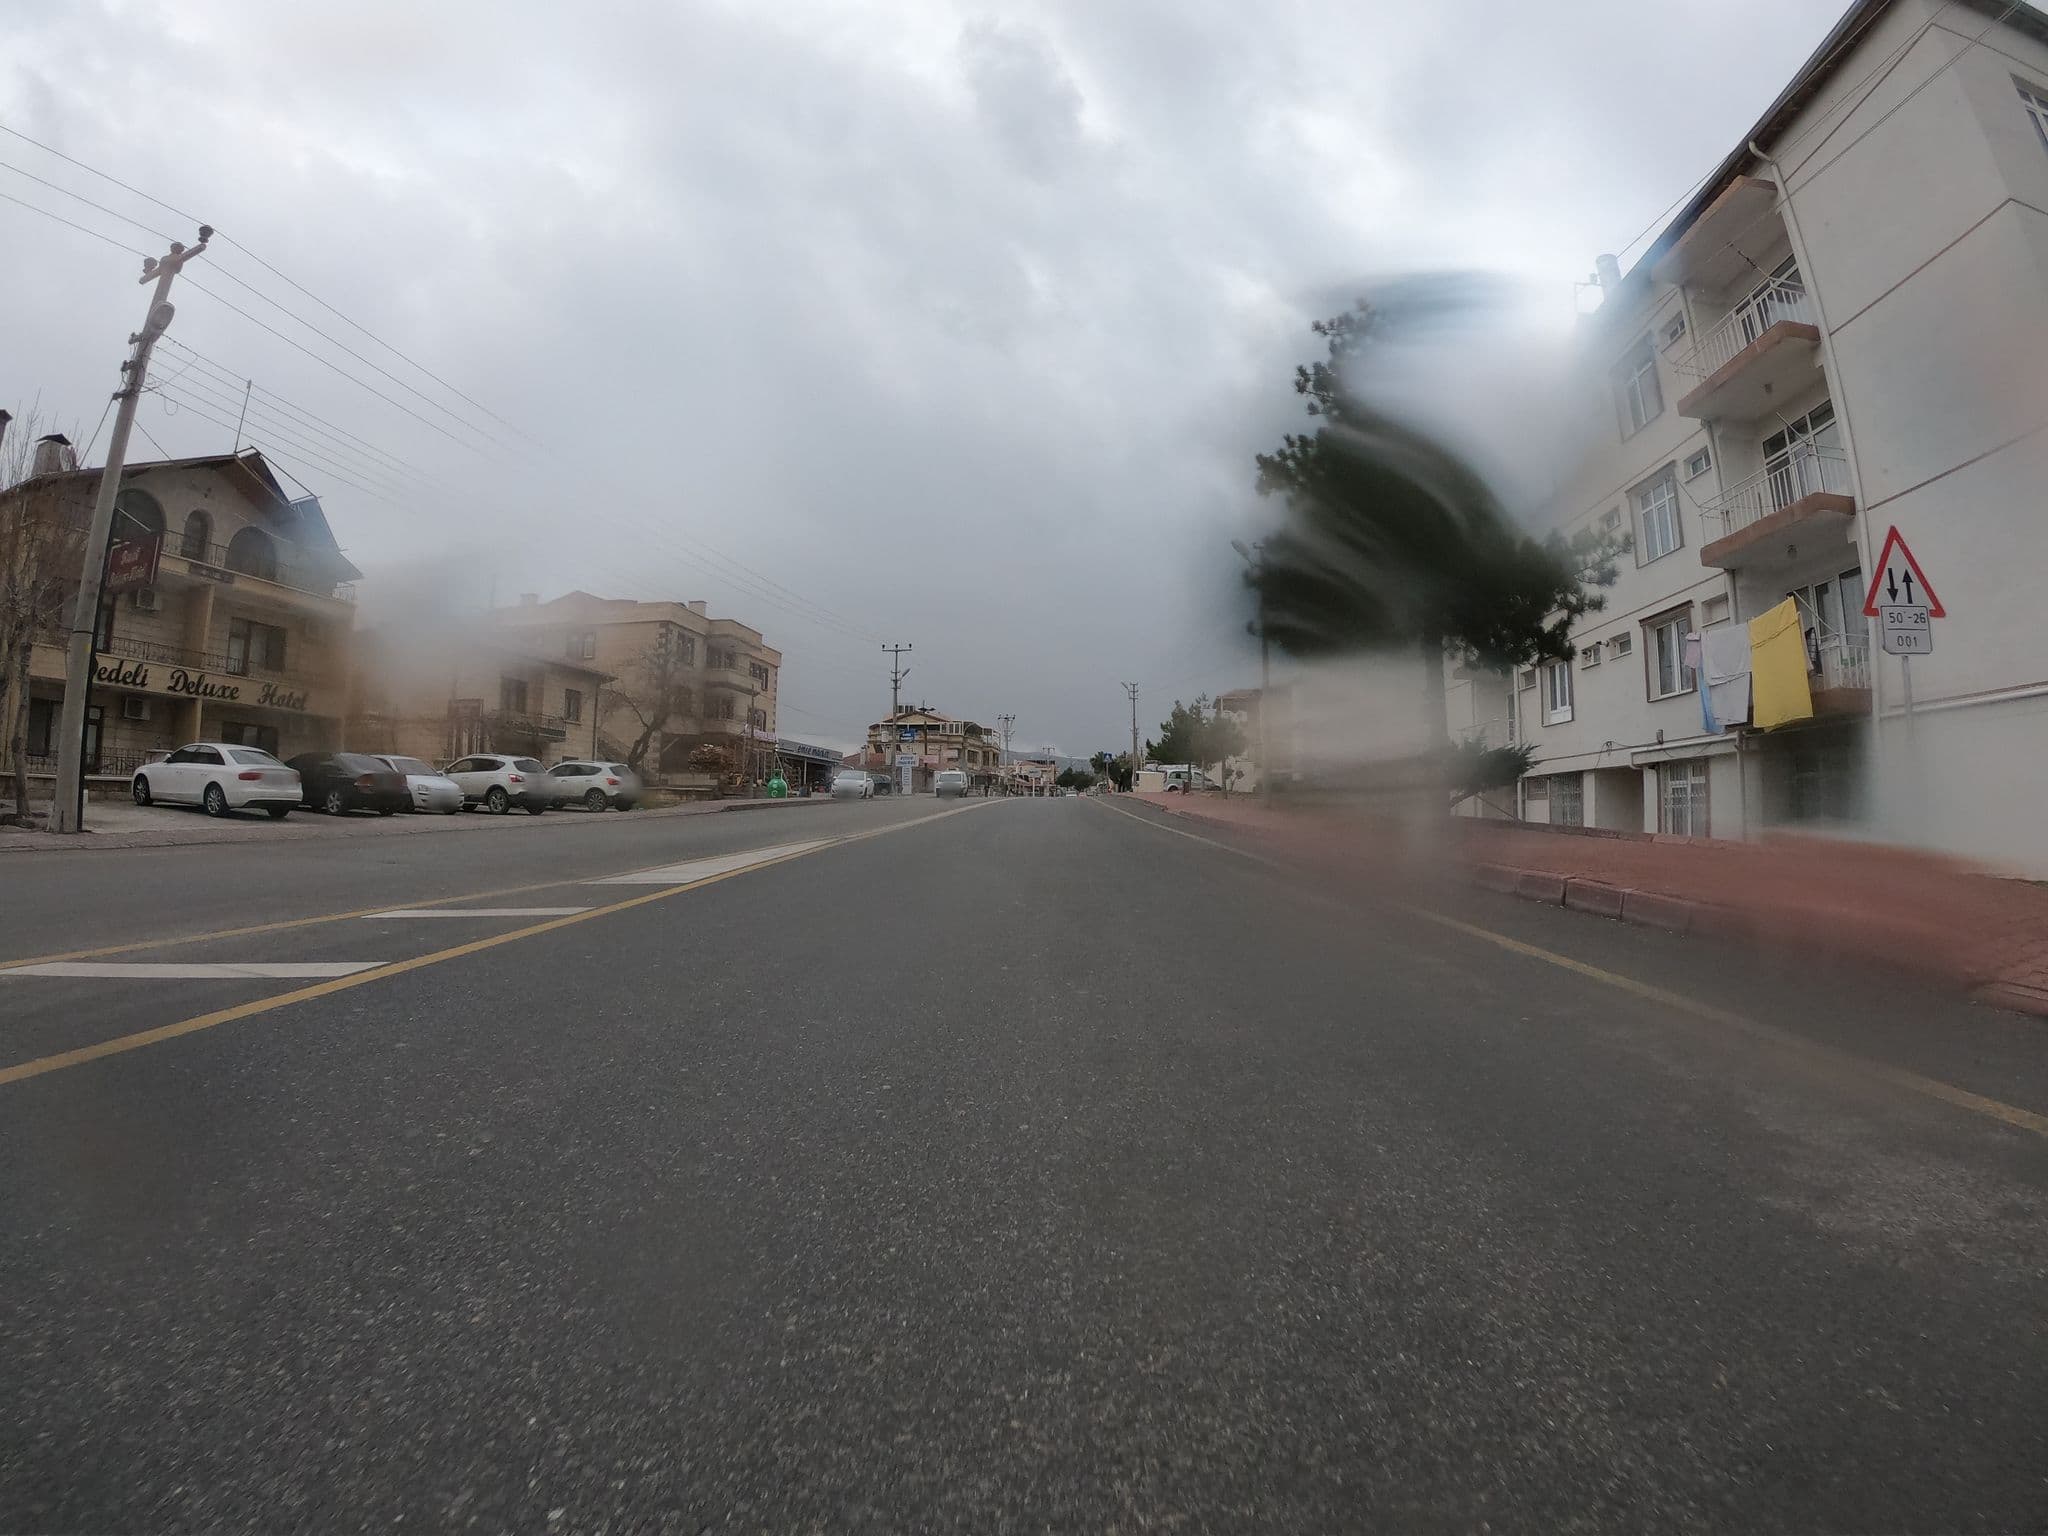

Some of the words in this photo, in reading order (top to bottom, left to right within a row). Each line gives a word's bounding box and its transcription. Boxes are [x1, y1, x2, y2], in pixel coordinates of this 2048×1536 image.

[1888, 612, 1903, 624] 50
[1896, 635, 1919, 648] 001
[167, 669, 240, 700] Deluxe
[257, 682, 311, 711] Hotel
